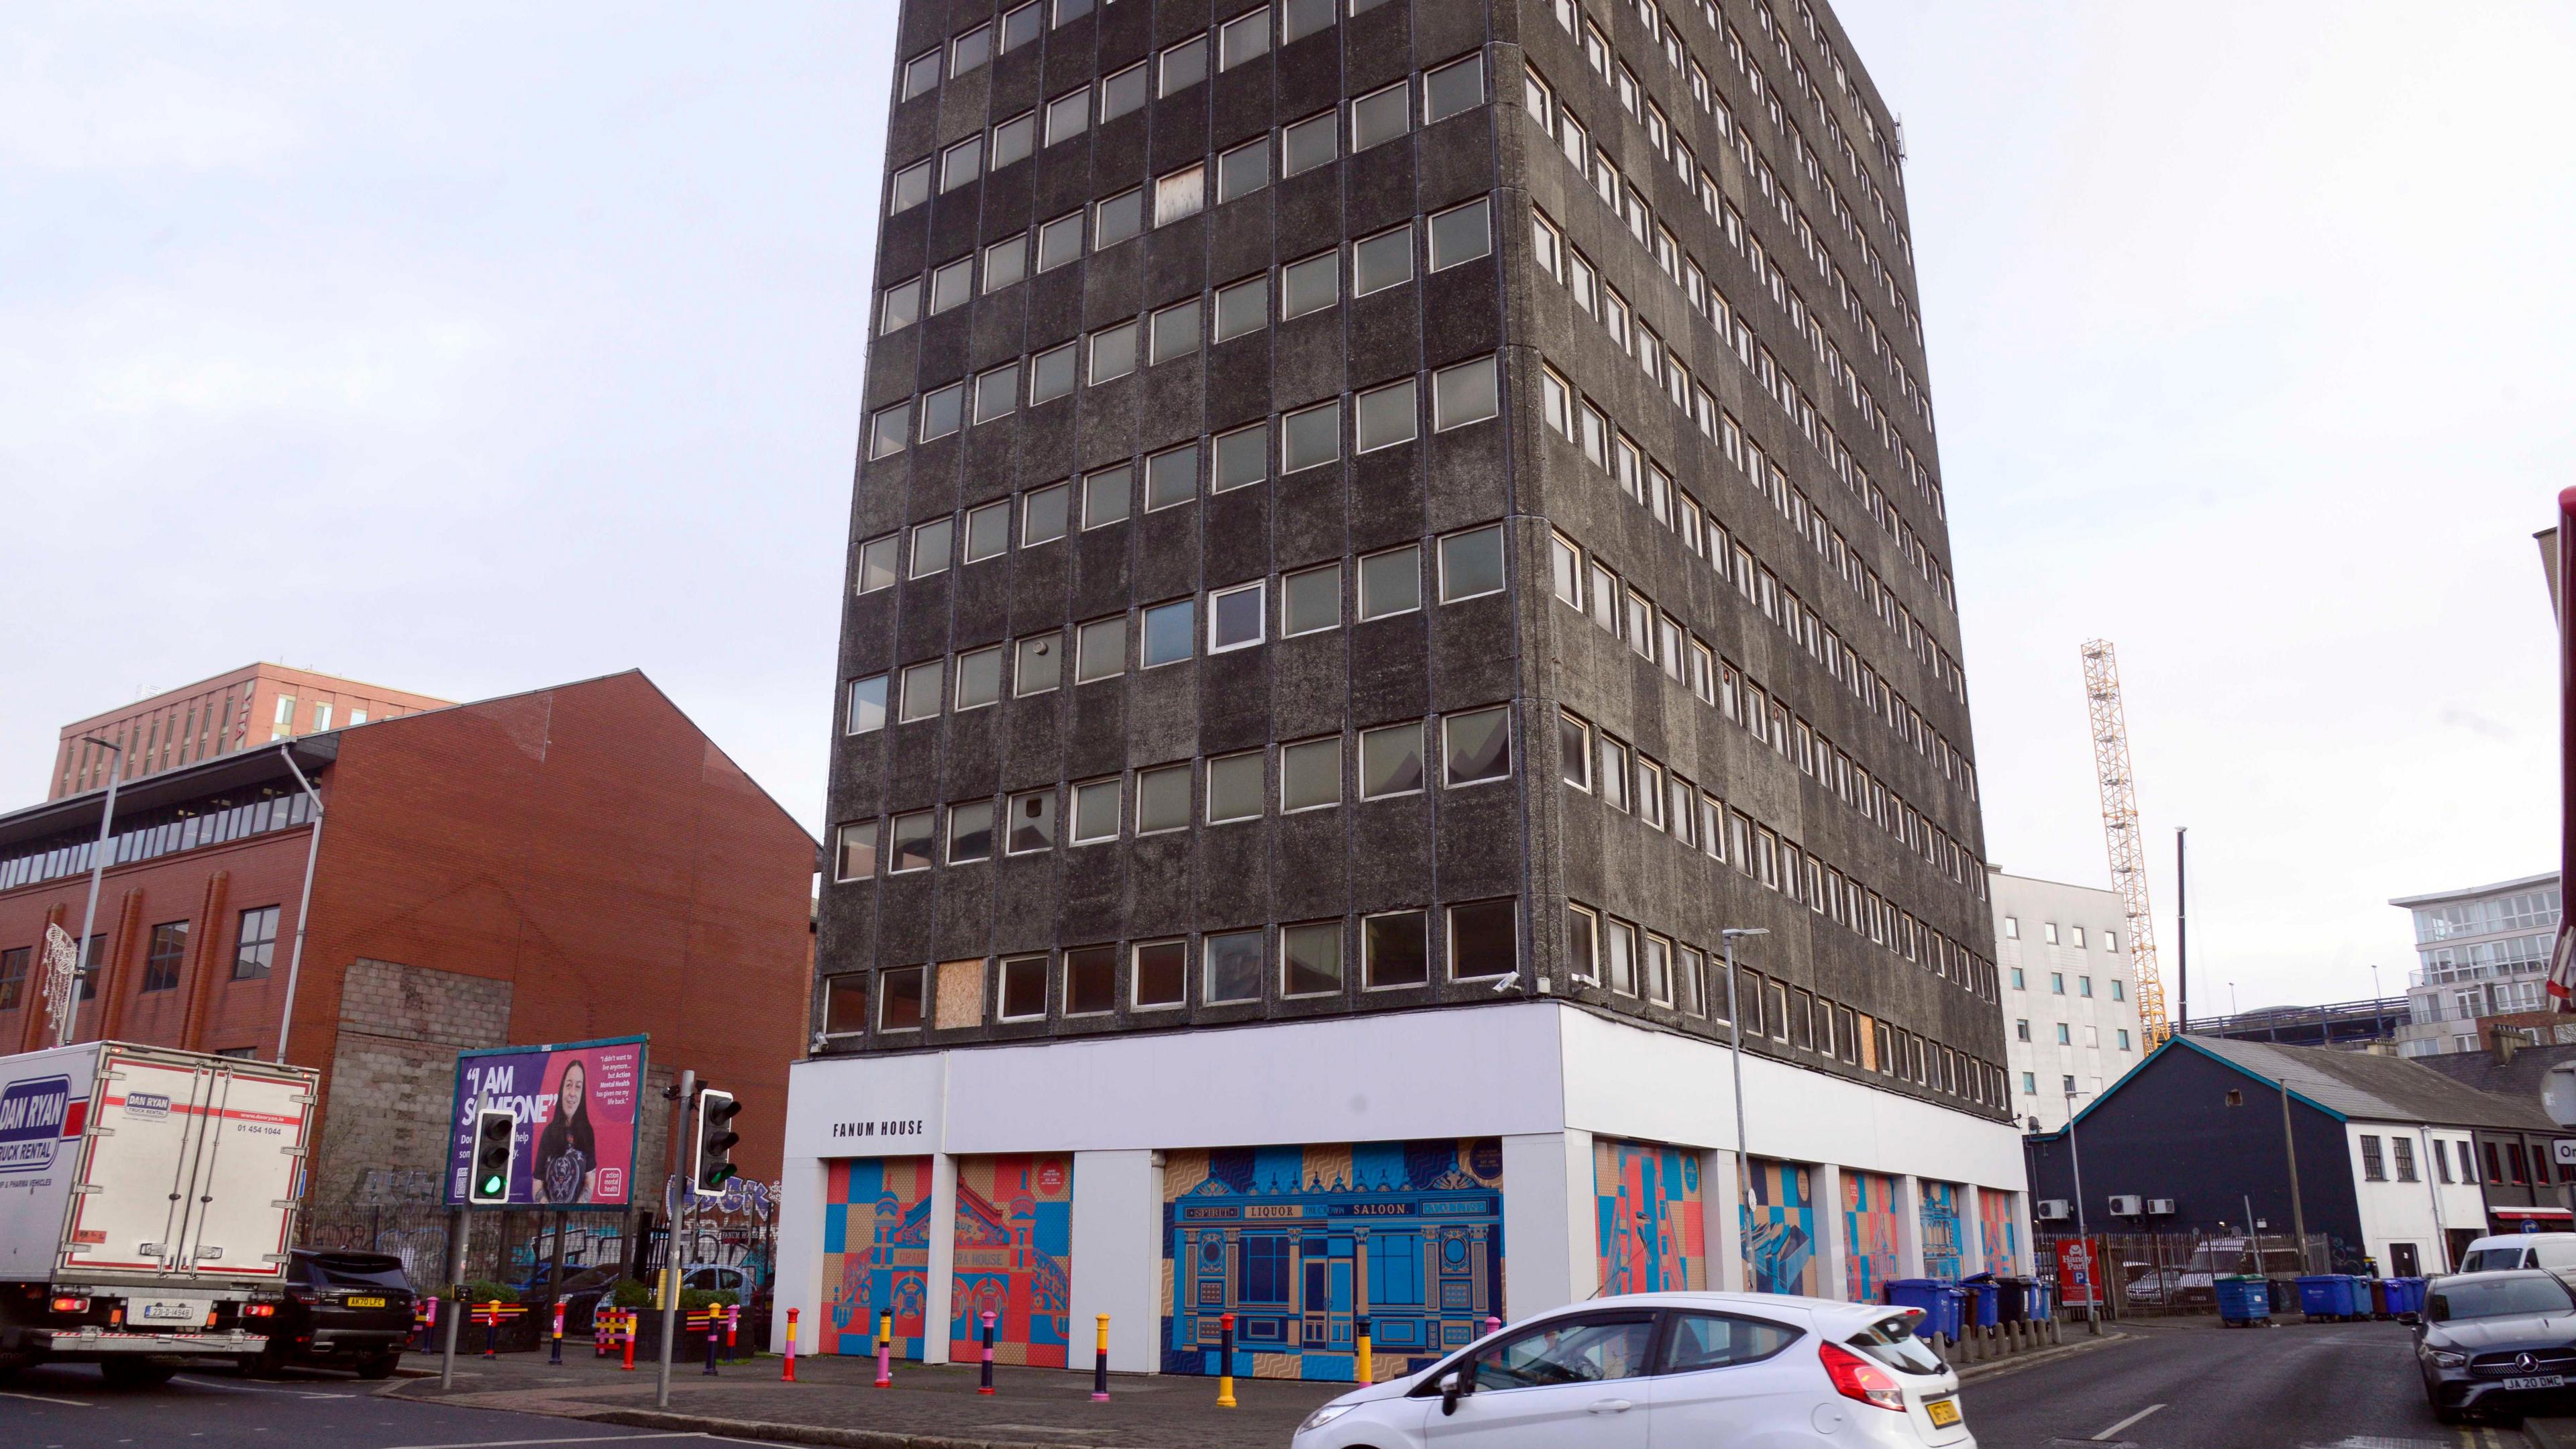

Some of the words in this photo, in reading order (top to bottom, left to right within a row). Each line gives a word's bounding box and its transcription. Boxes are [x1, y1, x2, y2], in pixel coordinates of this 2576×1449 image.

[482, 1065, 514, 1093] AM
[604, 1090, 614, 1098] given
[129, 1095, 146, 1106] DAN
[146, 1097, 168, 1108] RYAN
[0, 1097, 29, 1130] DAN
[25, 1092, 66, 1128] RYAN
[462, 1093, 559, 1126] SONE”
[248, 1126, 262, 1134] 454
[833, 1122, 874, 1137] FANUM
[881, 1120, 922, 1135] HOUSE
[515, 1132, 529, 1144] help
[0, 1144, 20, 1161] RUCK
[19, 1142, 51, 1160] RENTAL
[29, 1179, 52, 1187] VEHICLES
[1251, 1206, 1293, 1217] LIQUOR
[722, 1231, 740, 1239] FANUM
[741, 1231, 759, 1239] HSE
[900, 1252, 928, 1264] GRAND
[971, 1254, 1003, 1266] HOUSE
[2508, 1379, 2522, 1389] JA
[2523, 1379, 2538, 1388] 20
[2539, 1377, 2562, 1387] DMC
